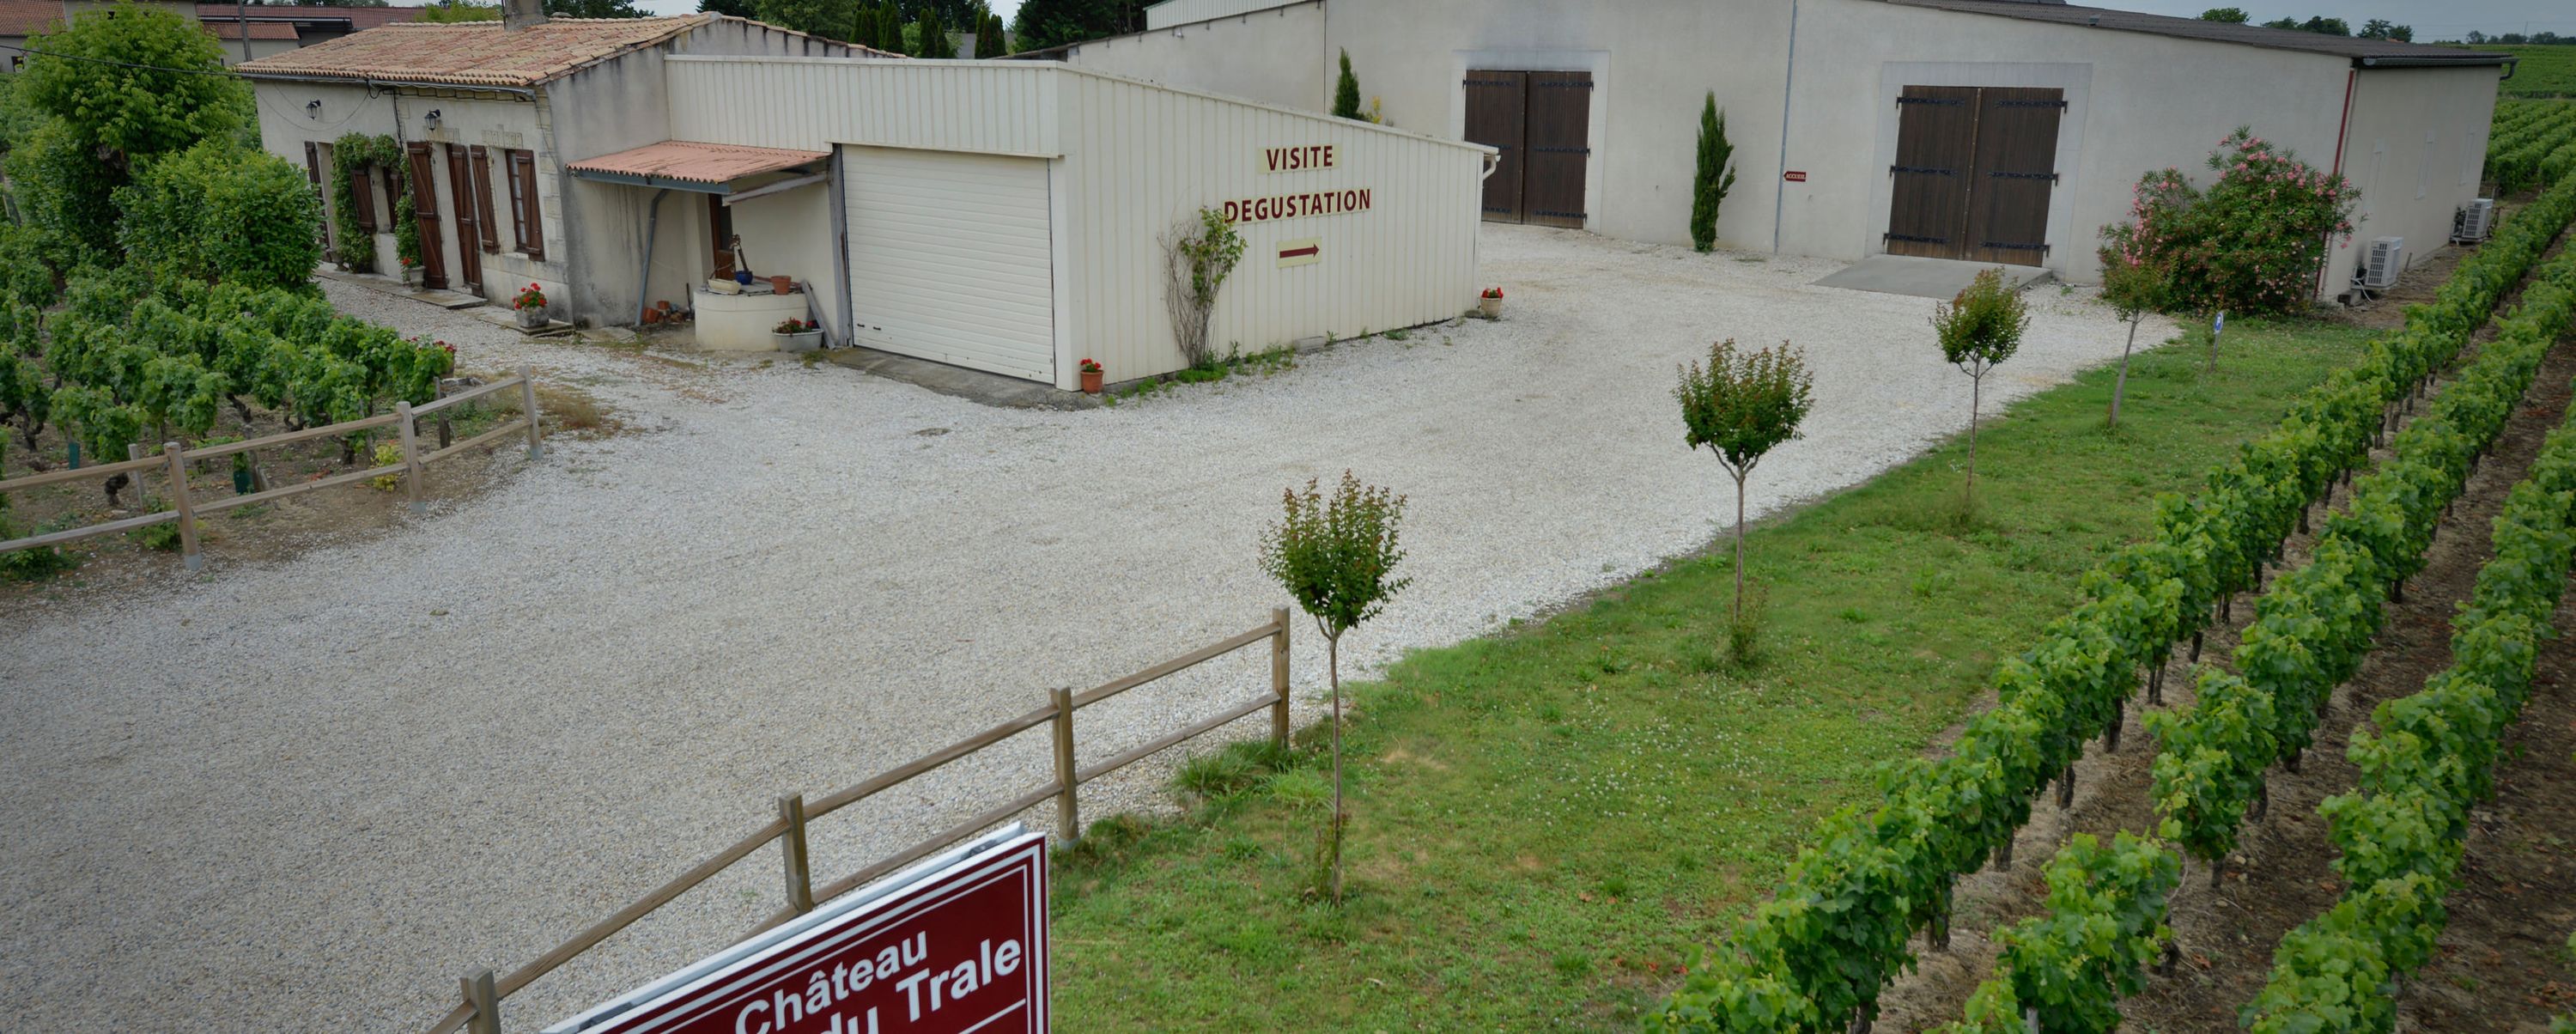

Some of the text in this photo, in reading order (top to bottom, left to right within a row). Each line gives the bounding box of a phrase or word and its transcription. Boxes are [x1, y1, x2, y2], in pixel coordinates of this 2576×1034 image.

[1267, 145, 1334, 171] VISITE
[1224, 189, 1370, 223] DEGUSTATION
[735, 931, 927, 1034] Château
[896, 939, 1021, 1023] Trale
